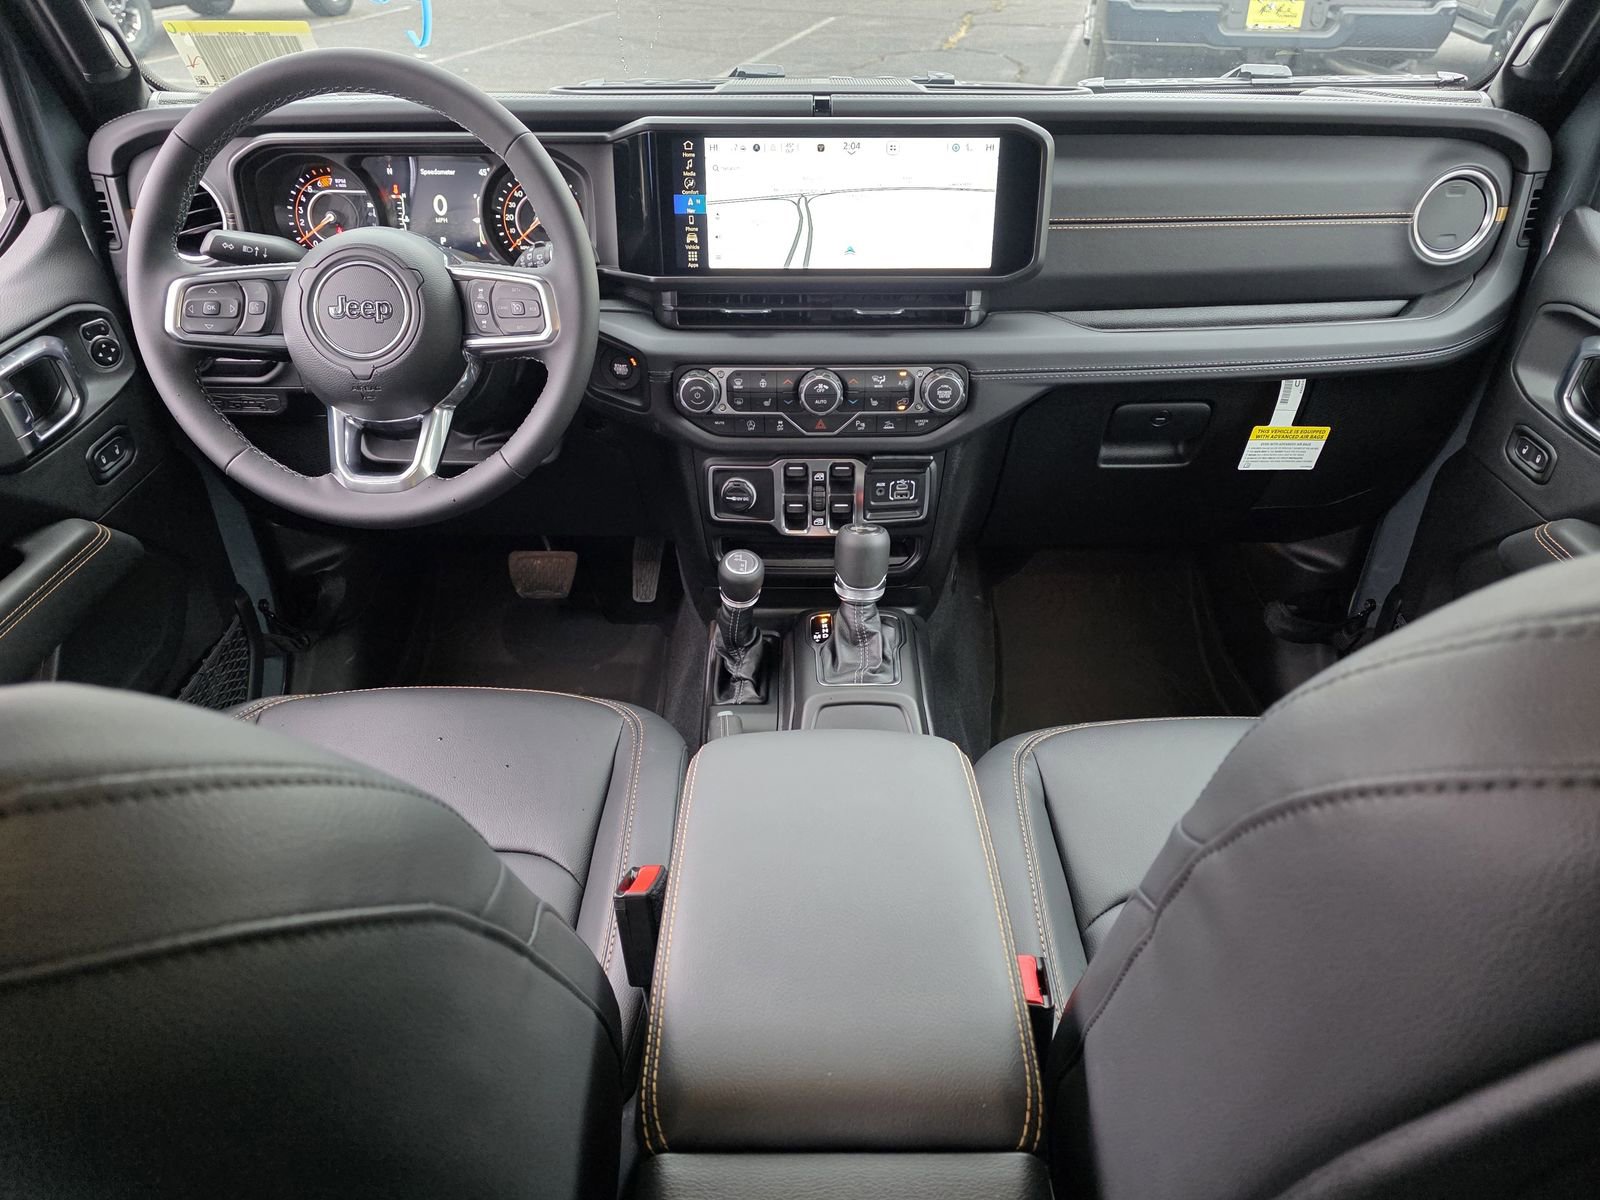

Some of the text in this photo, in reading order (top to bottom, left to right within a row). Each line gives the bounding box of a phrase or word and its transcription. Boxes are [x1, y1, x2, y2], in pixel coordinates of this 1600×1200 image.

[843, 142, 861, 150] 2:04
[420, 168, 456, 176] Speedometer
[432, 194, 448, 216] 0
[440, 236, 447, 245] P
[328, 294, 394, 324] Jeep
